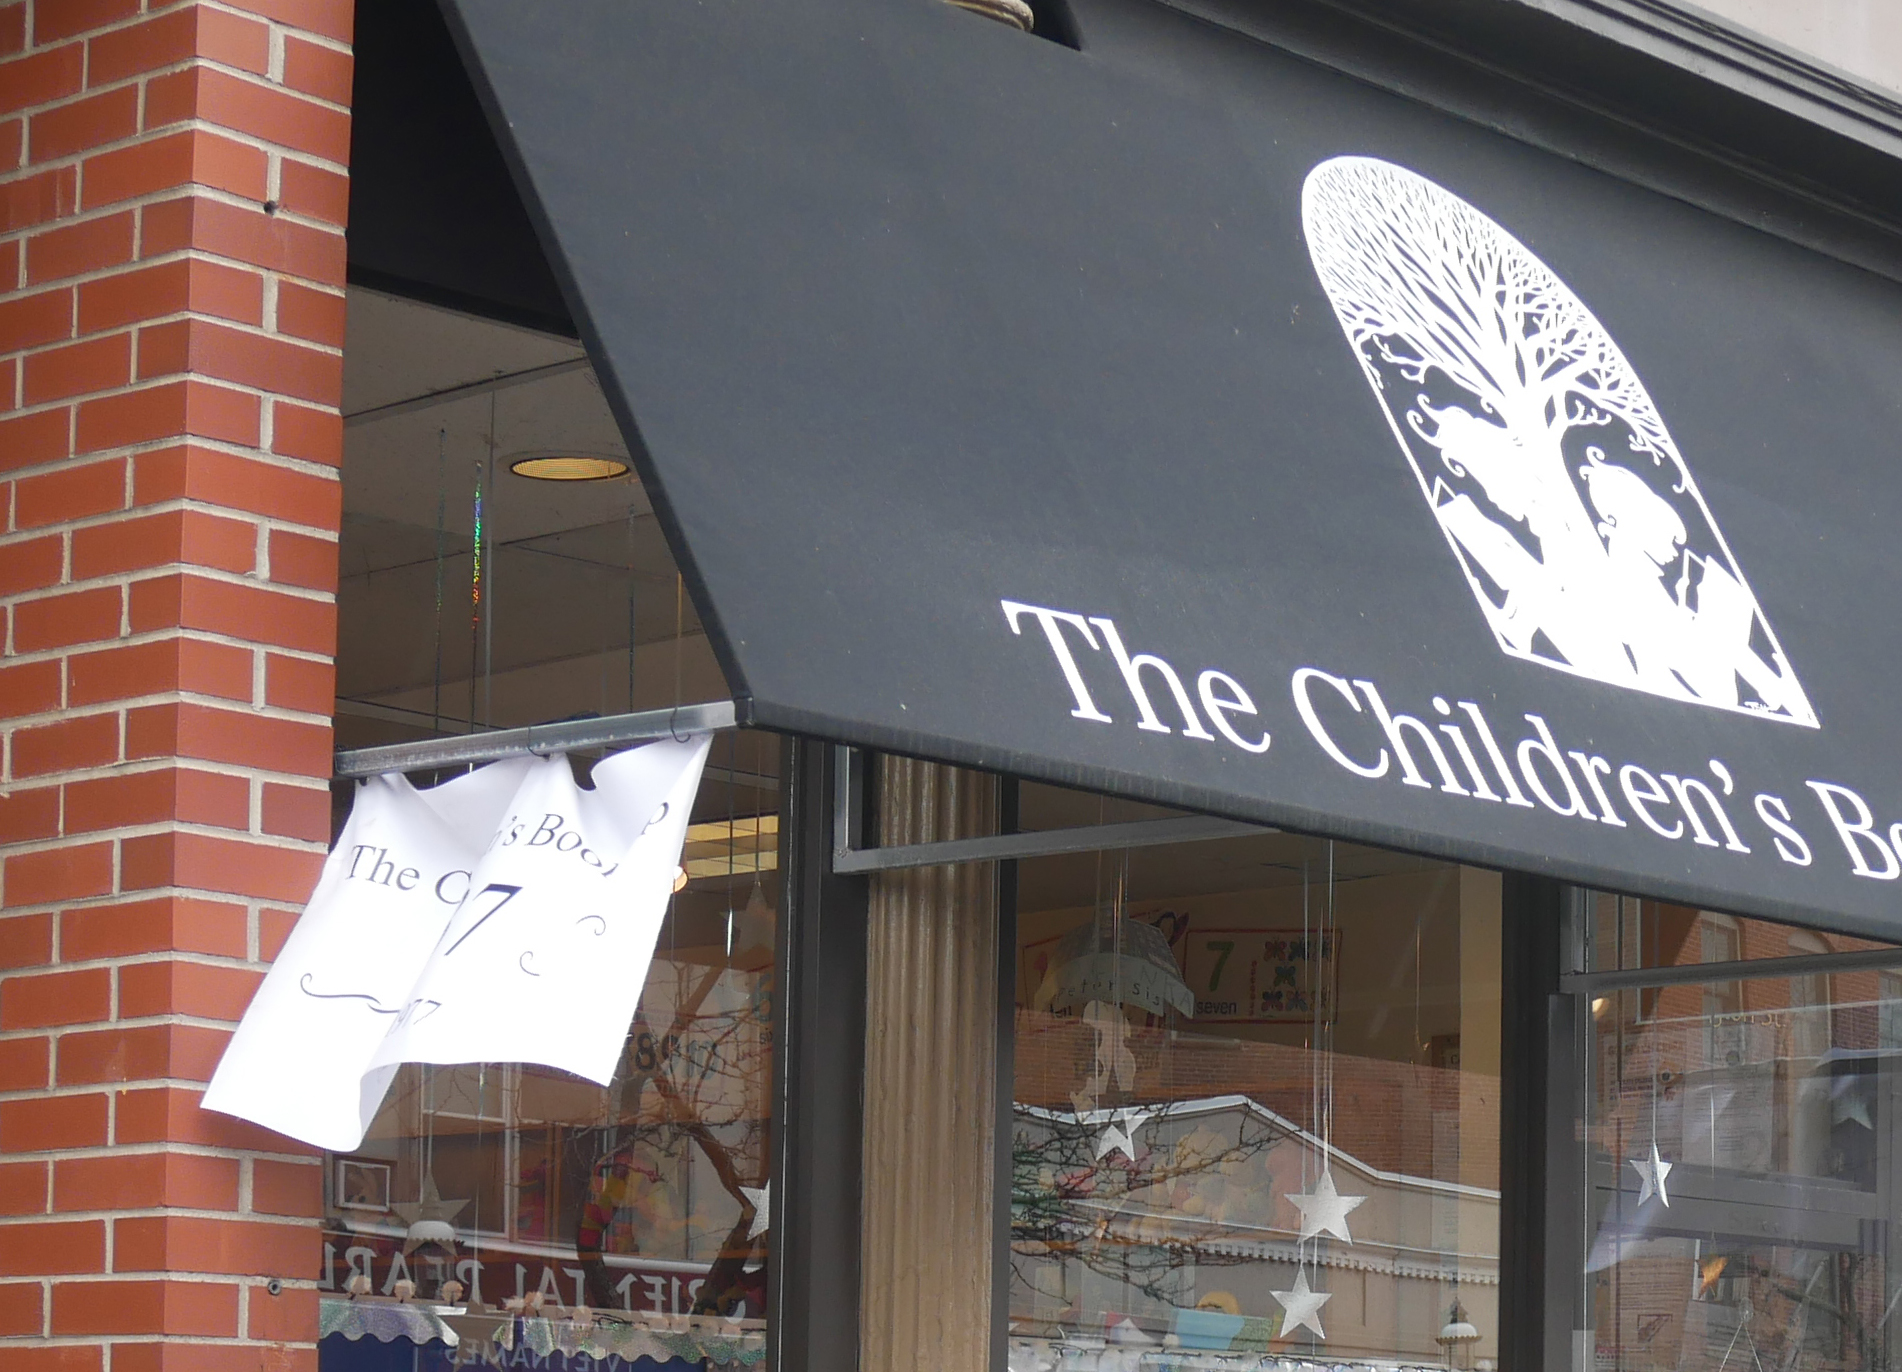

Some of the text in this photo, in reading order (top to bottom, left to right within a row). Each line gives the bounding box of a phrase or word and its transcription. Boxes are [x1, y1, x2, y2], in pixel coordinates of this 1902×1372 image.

[1003, 600, 1270, 754] The
[1291, 666, 1812, 867] Children's
[345, 844, 420, 891] The
[443, 882, 524, 957] 7
[1207, 940, 1236, 993] 7
[1196, 999, 1238, 1016] seven
